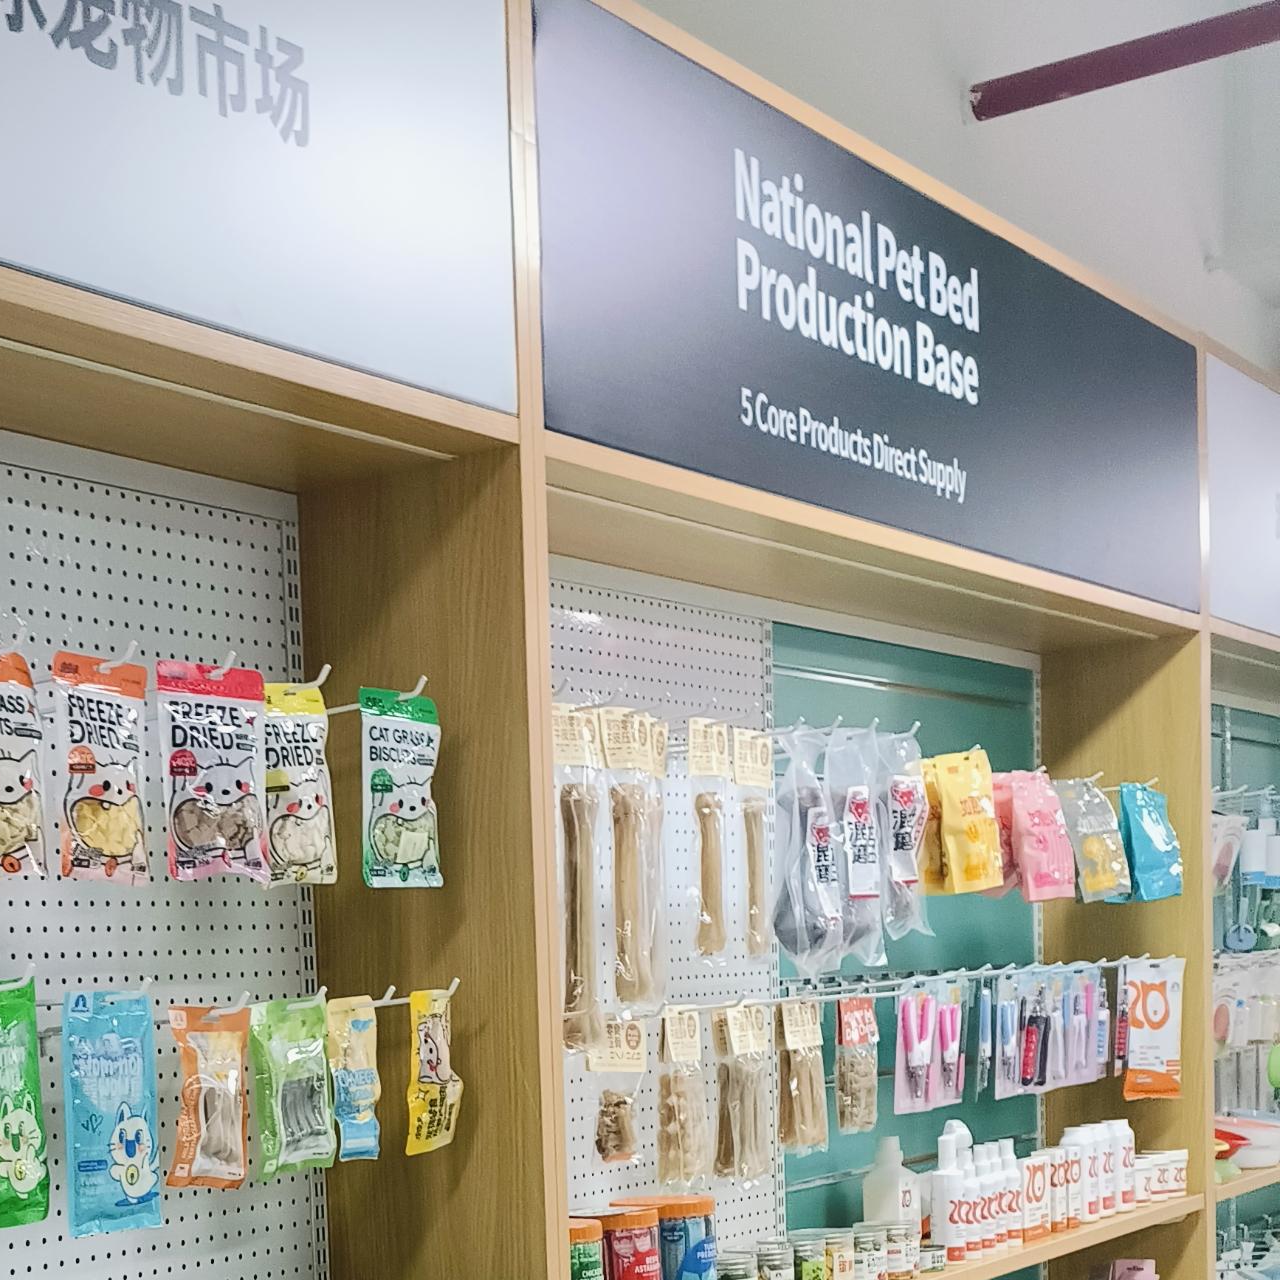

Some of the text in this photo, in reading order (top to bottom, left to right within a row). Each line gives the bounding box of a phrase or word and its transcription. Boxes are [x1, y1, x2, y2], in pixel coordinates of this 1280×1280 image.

[734, 148, 980, 333] National Pet Bed
[736, 238, 979, 405] Production Base
[740, 387, 967, 504] 5 Core Products Direct Supply
[69, 719, 120, 749] DRIED
[171, 725, 234, 750] DRIED
[369, 725, 389, 742] CAT
[265, 746, 313, 768] DRIED
